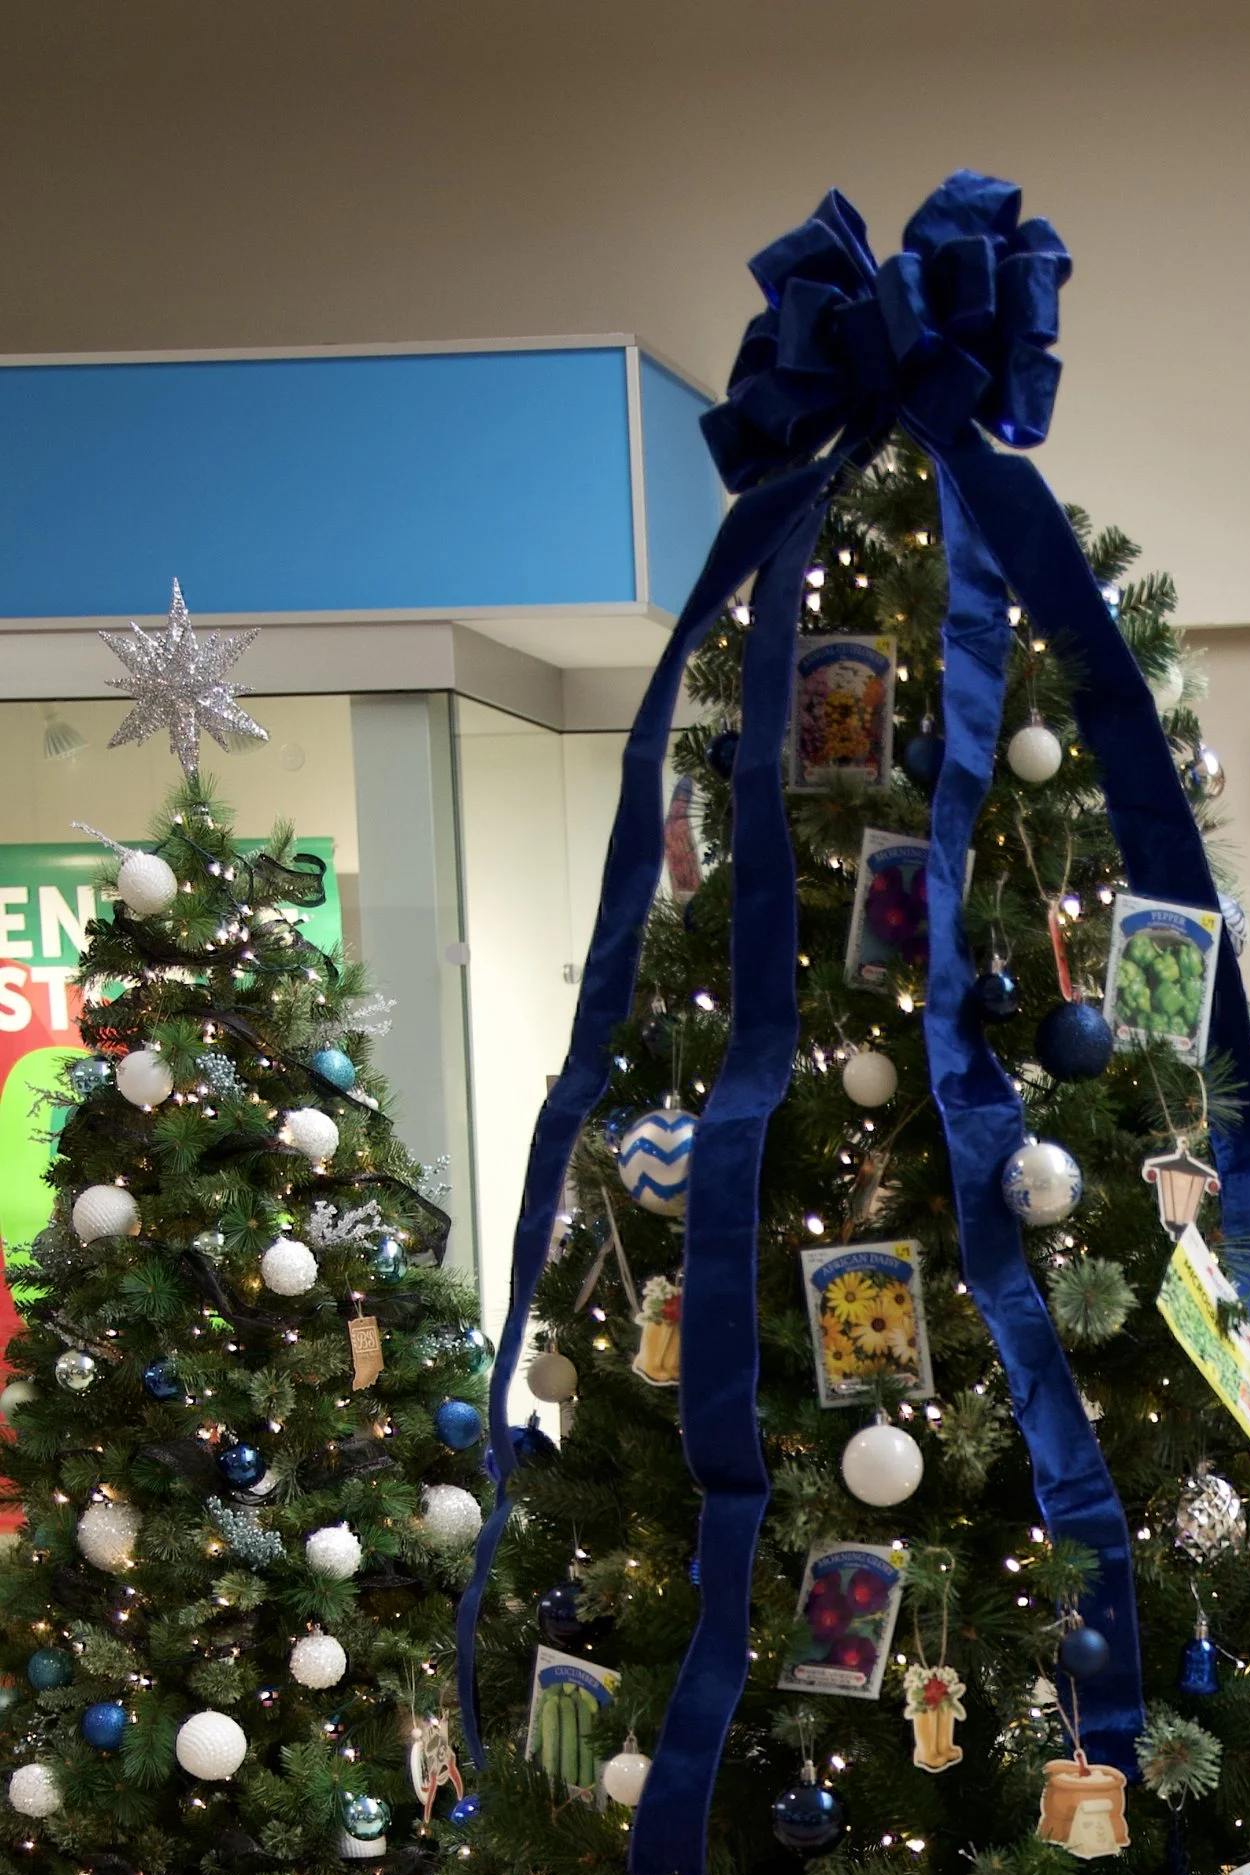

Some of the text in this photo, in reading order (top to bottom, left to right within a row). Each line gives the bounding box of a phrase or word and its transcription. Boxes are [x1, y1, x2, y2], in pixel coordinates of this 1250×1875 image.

[1151, 910, 1186, 925] PEPPER
[822, 1253, 900, 1276] AFRICAN DAISY
[818, 1552, 893, 1575] MORNING GLORY
[554, 1666, 600, 1689] CUCUMBER
